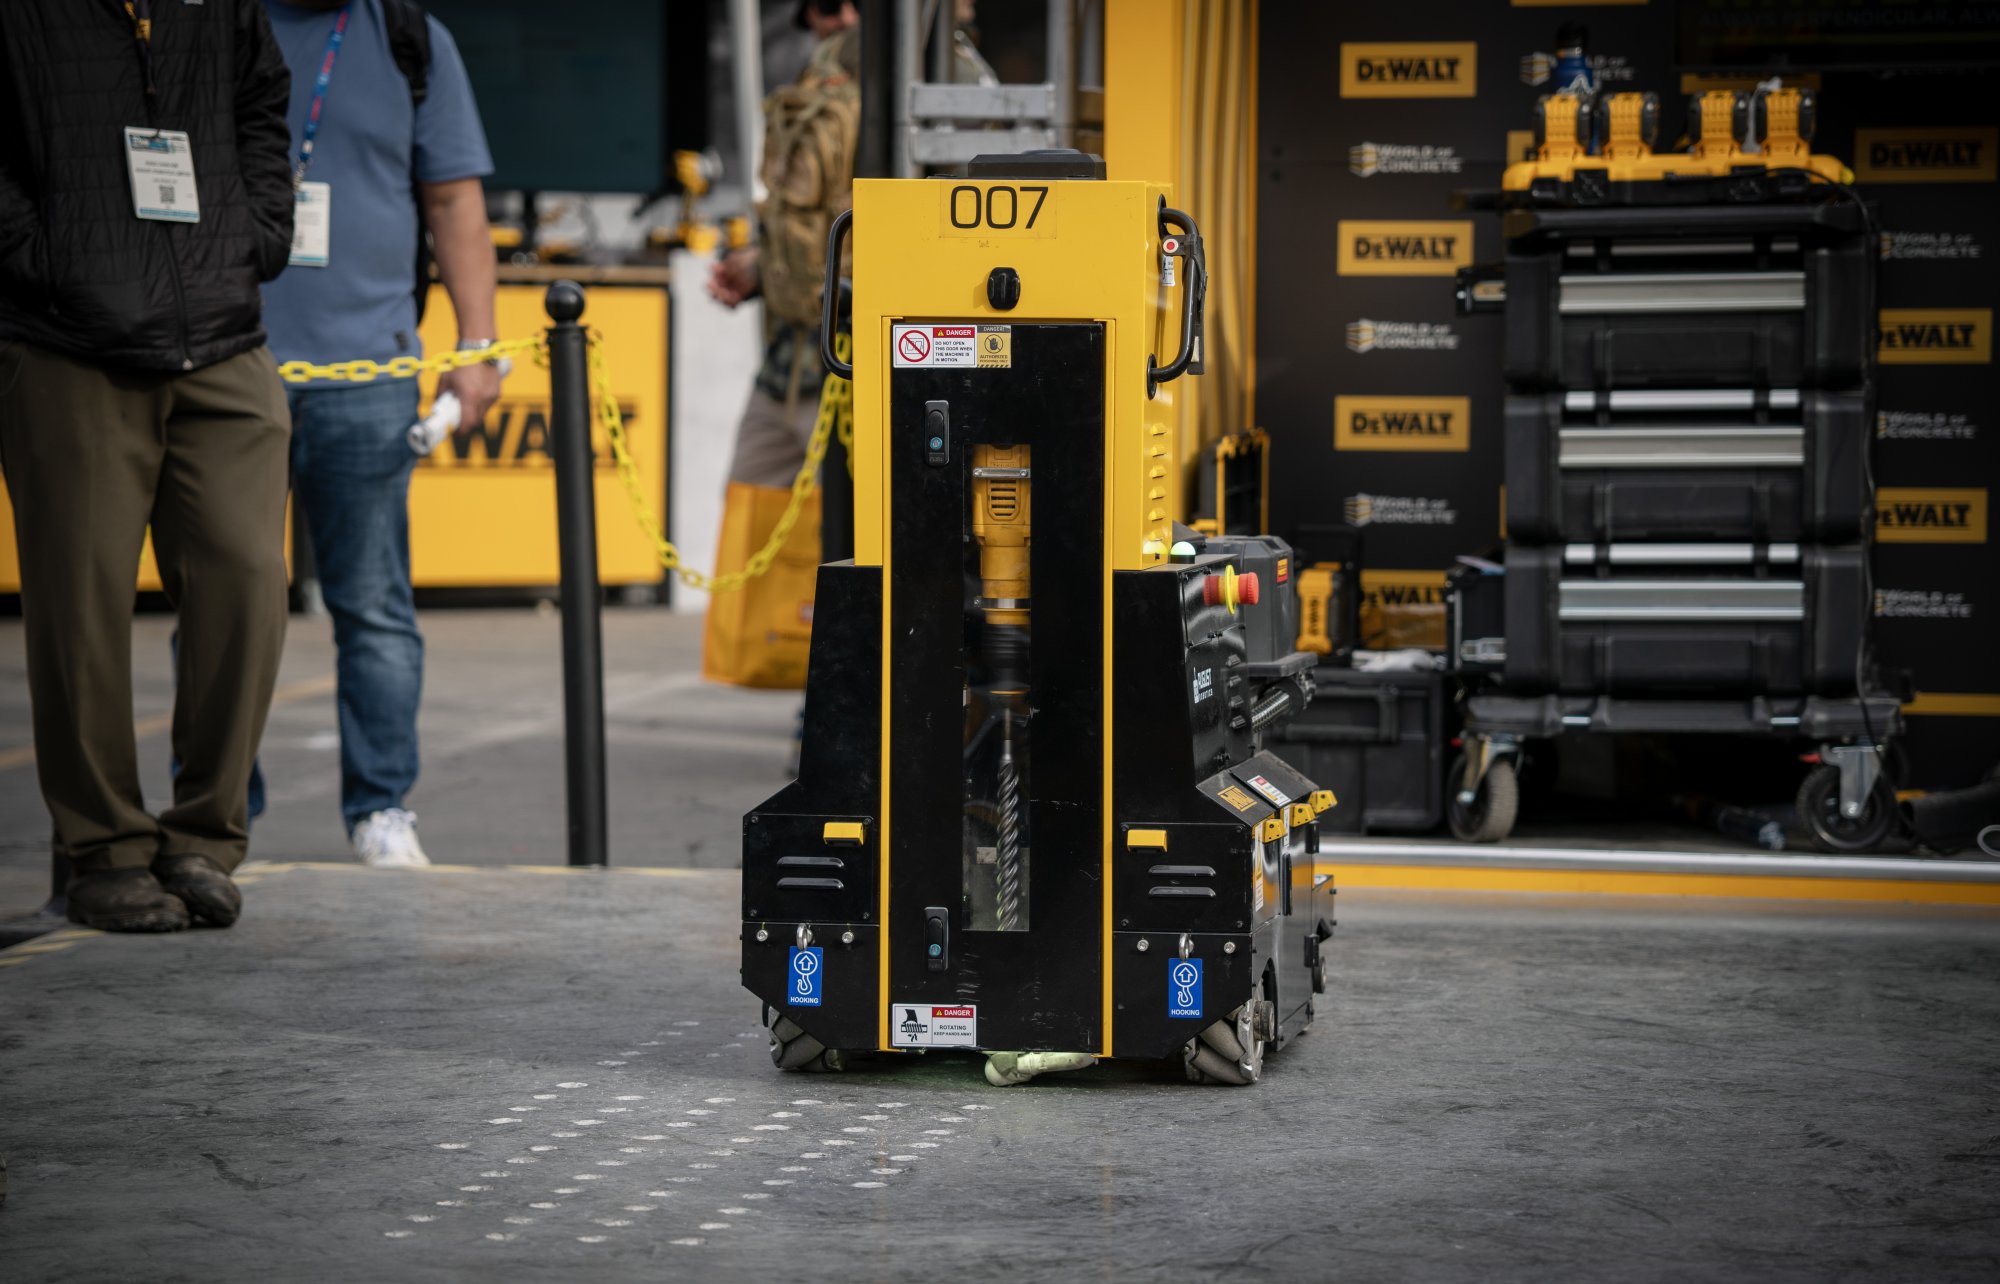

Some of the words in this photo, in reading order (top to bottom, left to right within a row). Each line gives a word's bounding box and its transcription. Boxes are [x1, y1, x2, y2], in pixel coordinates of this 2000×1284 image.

[1377, 144, 1434, 158] WORLD
[1377, 157, 1463, 172] CONCRETE
[950, 185, 1049, 229] 007
[1375, 322, 1432, 335] WORLD
[1375, 335, 1458, 349] CONCRETE
[1374, 497, 1429, 510] WORLD
[1373, 510, 1456, 523] CONCRETE
[790, 996, 819, 1004] HOOKING
